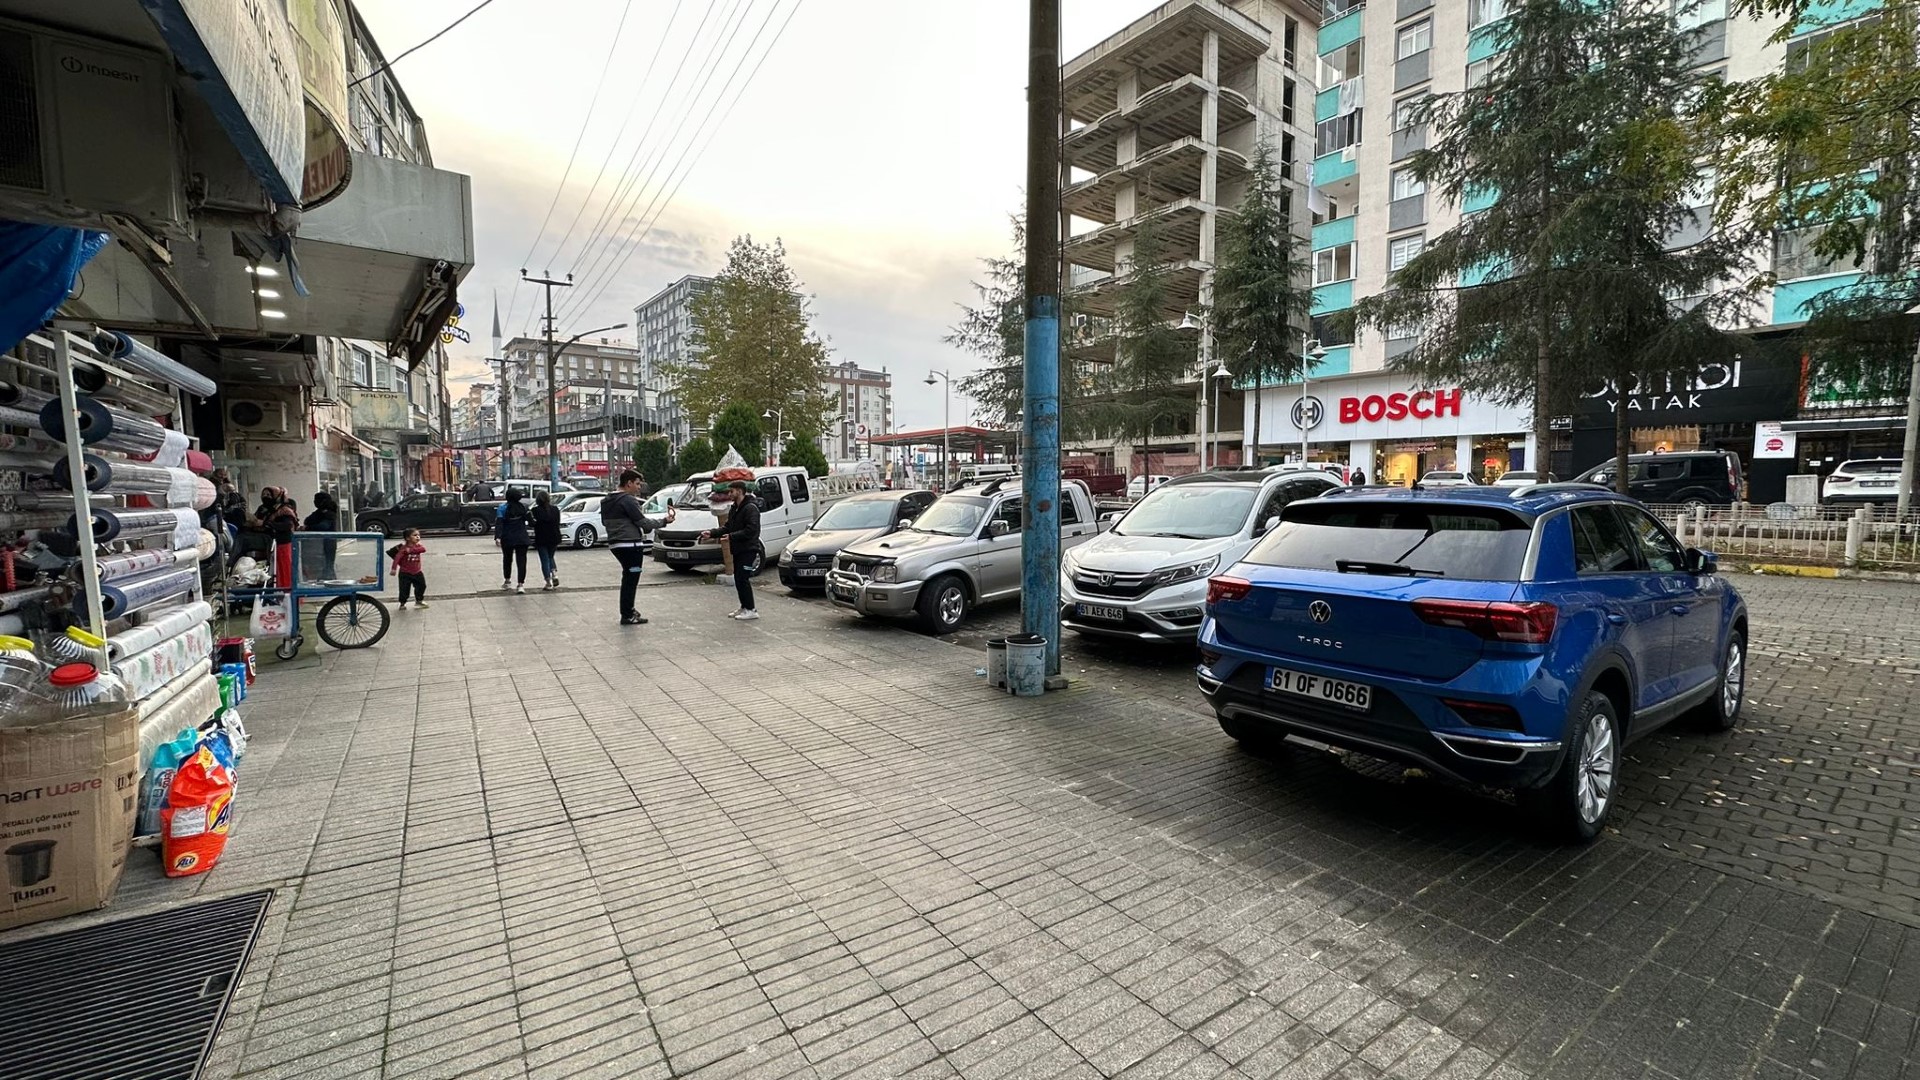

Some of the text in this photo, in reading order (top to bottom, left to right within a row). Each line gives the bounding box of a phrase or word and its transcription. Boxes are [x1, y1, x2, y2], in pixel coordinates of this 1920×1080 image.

[1339, 387, 1462, 424] BOSCH
[1607, 393, 1702, 413] YATAK
[1081, 604, 1122, 619] 61 AEK 646
[1298, 635, 1343, 649] T-ROC
[1273, 669, 1368, 706] 61 OF 0666
[46, 778, 102, 797] ware
